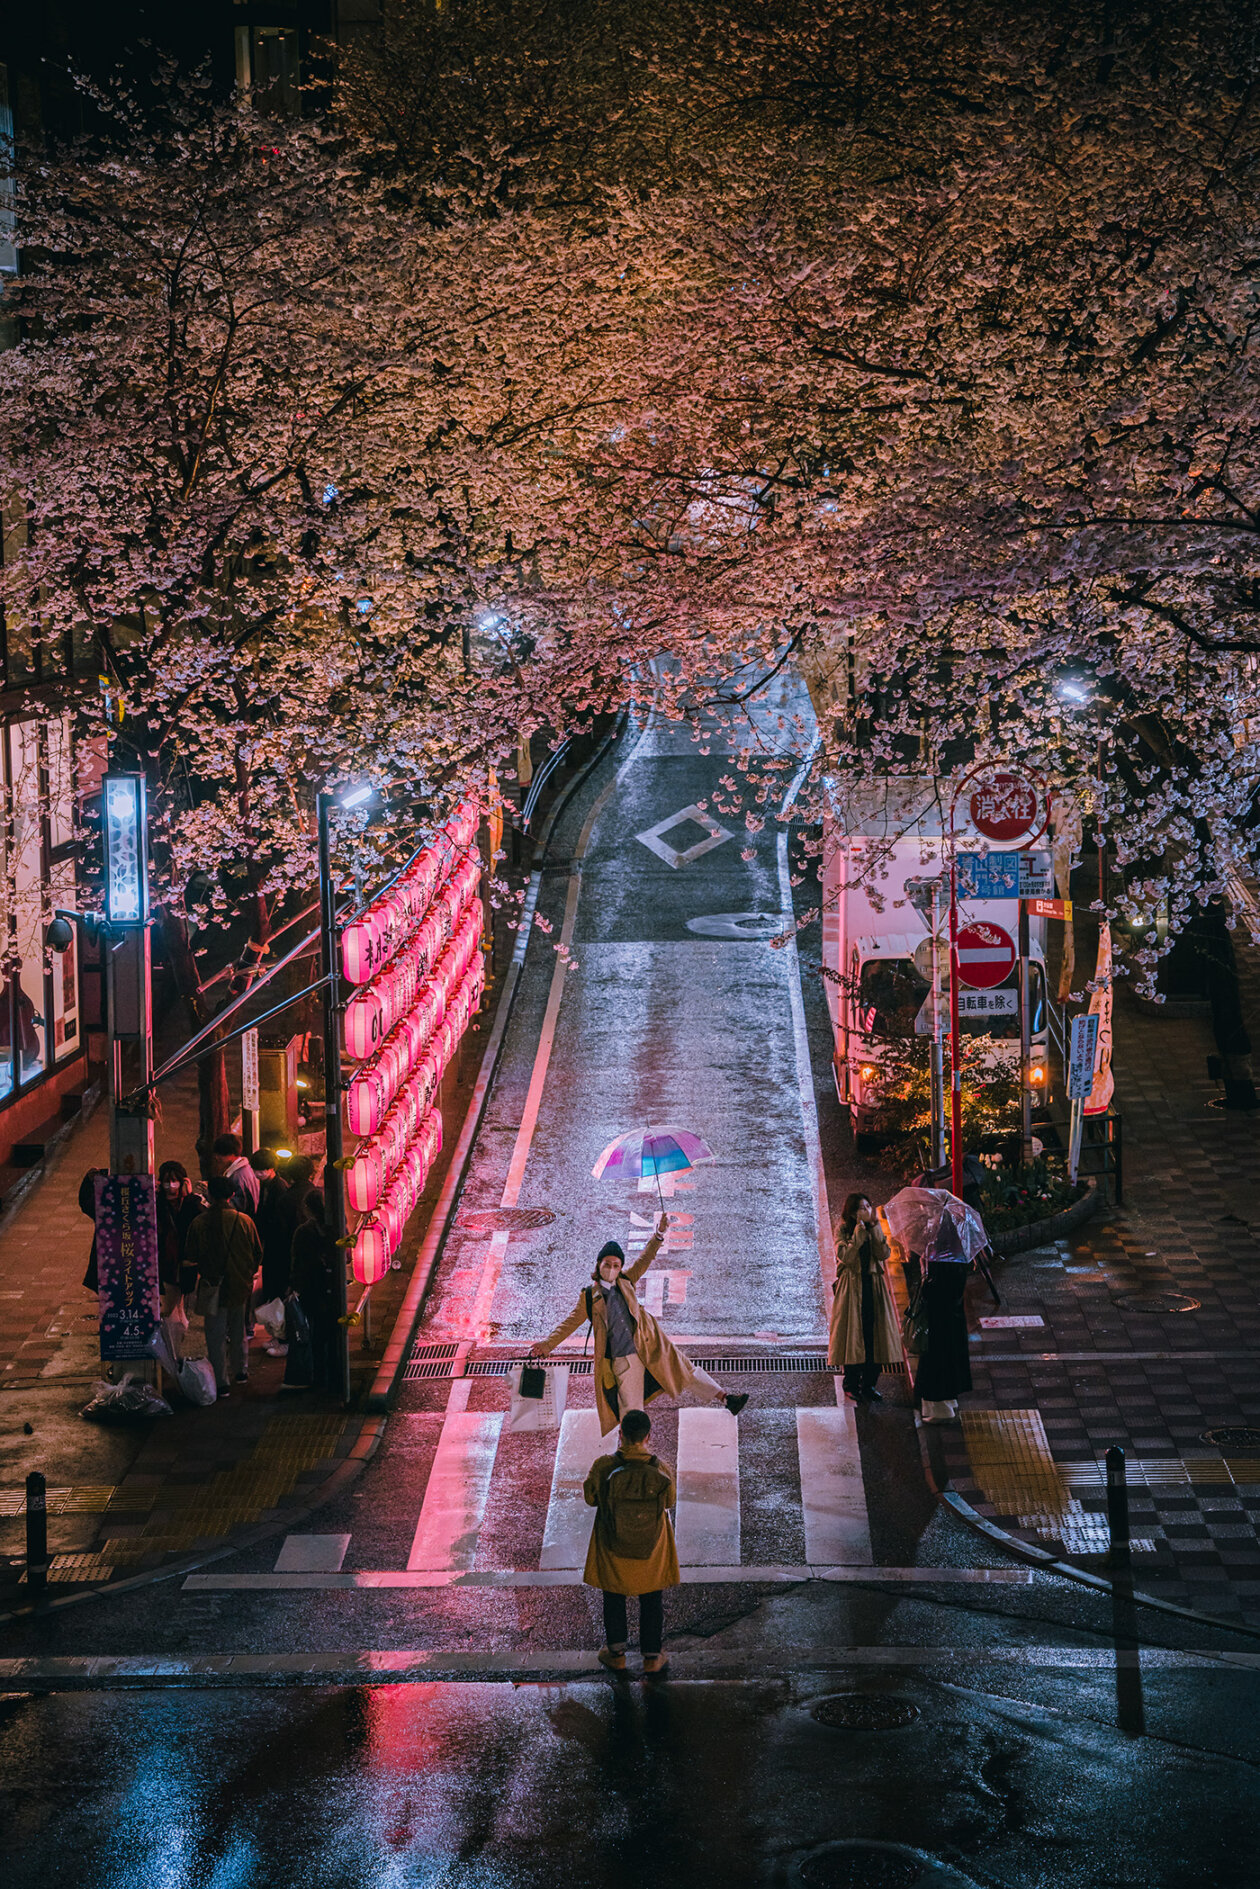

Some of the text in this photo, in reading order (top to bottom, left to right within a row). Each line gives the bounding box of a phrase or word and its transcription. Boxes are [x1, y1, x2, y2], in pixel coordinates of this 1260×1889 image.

[958, 995, 1013, 1011] 自転車を除く
[119, 1309, 139, 1320] 3.14
[123, 1325, 140, 1336] 4.5
